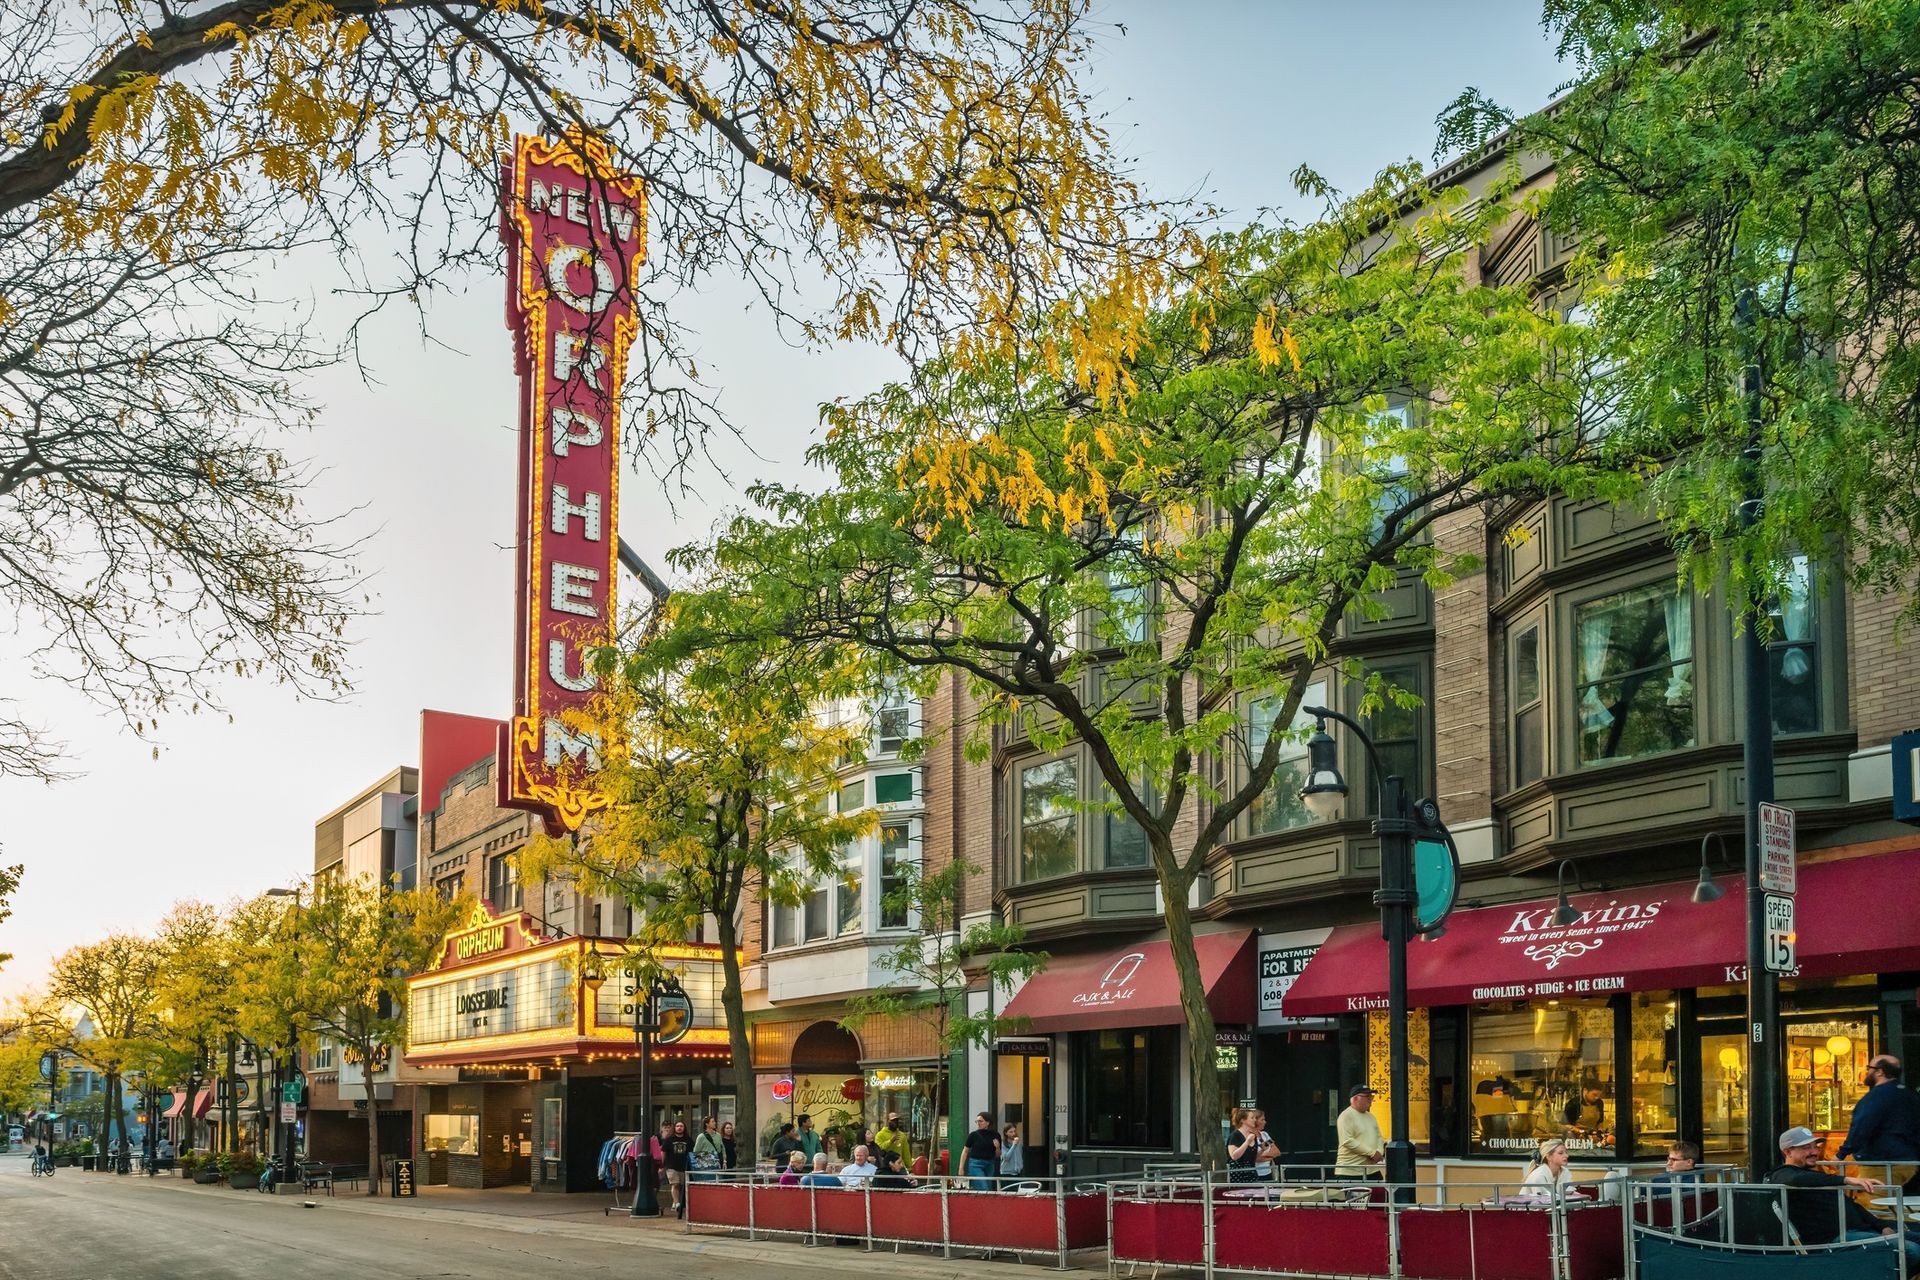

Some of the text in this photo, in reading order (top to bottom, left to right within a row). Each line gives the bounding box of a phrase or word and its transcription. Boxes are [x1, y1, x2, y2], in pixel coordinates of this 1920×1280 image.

[531, 177, 635, 243] NEW
[544, 244, 615, 772] ORPHEUM
[1763, 808, 1792, 828] NO TRUCK
[1765, 824, 1791, 839] STOPPING
[1765, 836, 1791, 850] STANDING
[1767, 851, 1790, 865] PARKING
[1767, 901, 1792, 918] SPEED
[1539, 929, 1565, 940] every
[1595, 923, 1620, 935] since
[1770, 916, 1790, 932] LIMIT
[456, 926, 505, 960] ORPHEUM
[1769, 933, 1791, 966] 15
[1263, 960, 1289, 976] FOR
[1268, 980, 1274, 988] 2
[1284, 978, 1290, 986] 3
[1472, 977, 1625, 999] CHOCOLATES FUDGE ICE CREAM
[1072, 988, 1137, 1003] CASK & ALE
[1216, 1033, 1231, 1041] CASK
[1232, 1033, 1238, 1041] &
[1301, 1033, 1309, 1041] ICE
[1055, 1105, 1067, 1113] 212
[1488, 1138, 1594, 1150] CHOCOLATES CREAM
[398, 1161, 411, 1195] TATTOO
